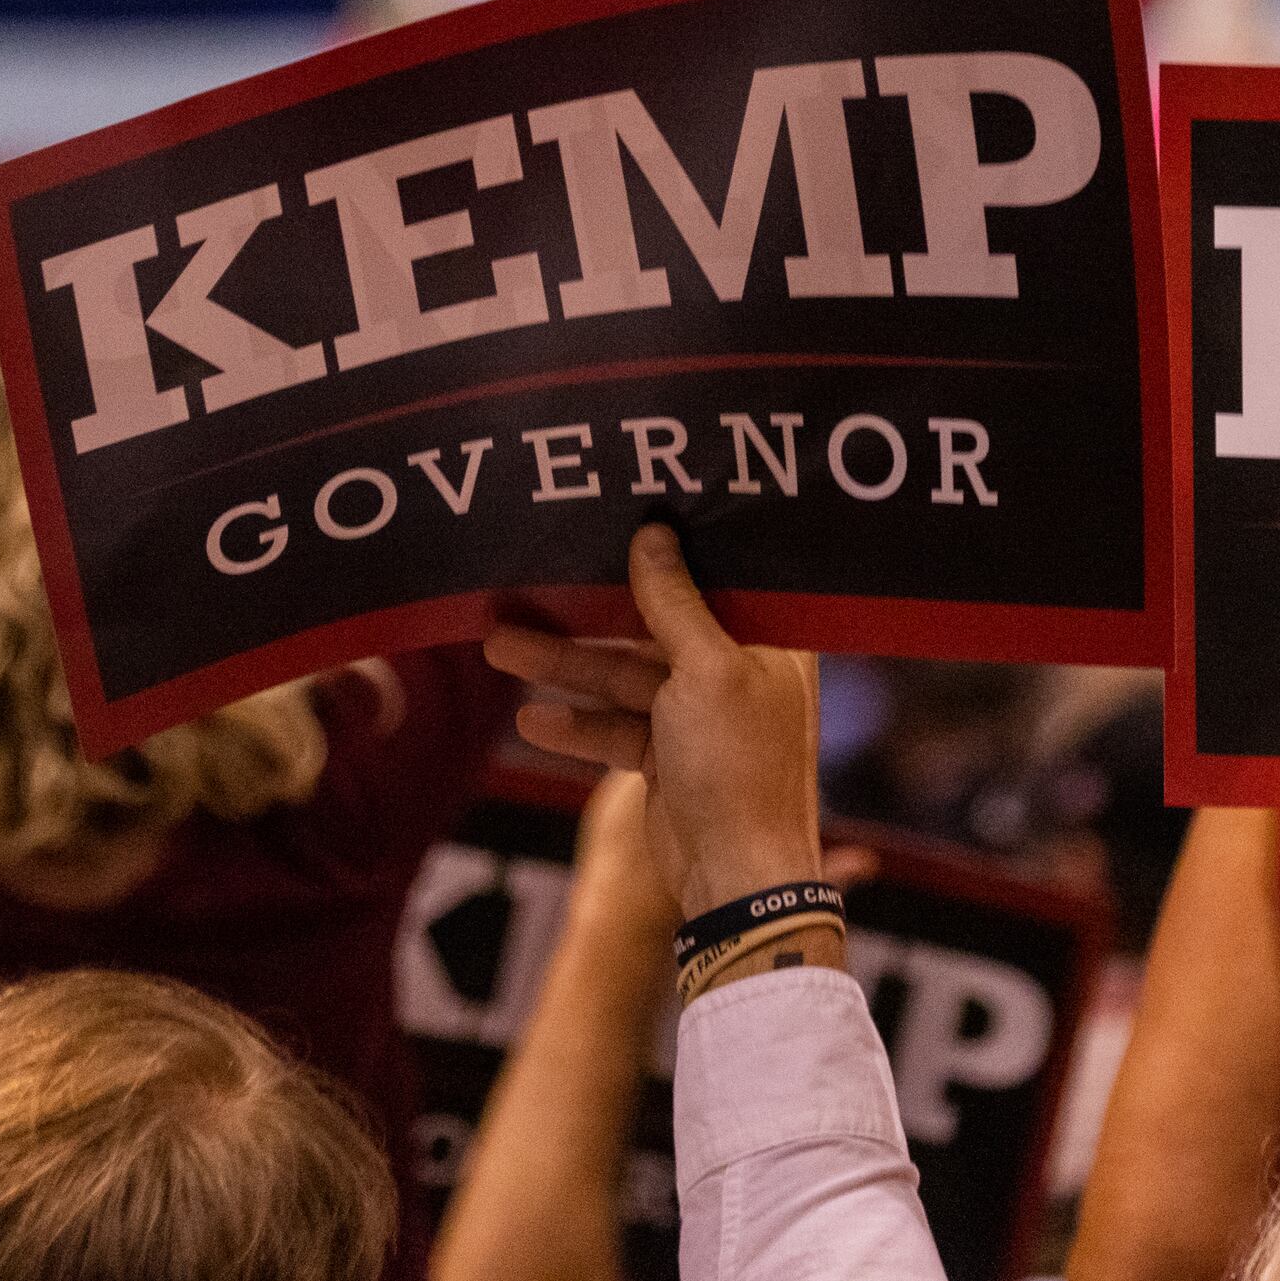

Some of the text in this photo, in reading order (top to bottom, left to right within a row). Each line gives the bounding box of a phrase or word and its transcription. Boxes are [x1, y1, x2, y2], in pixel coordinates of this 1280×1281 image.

[39, 50, 1104, 455] KEMP
[203, 411, 1000, 576] GOVERNOR
[750, 889, 798, 918] GOD
